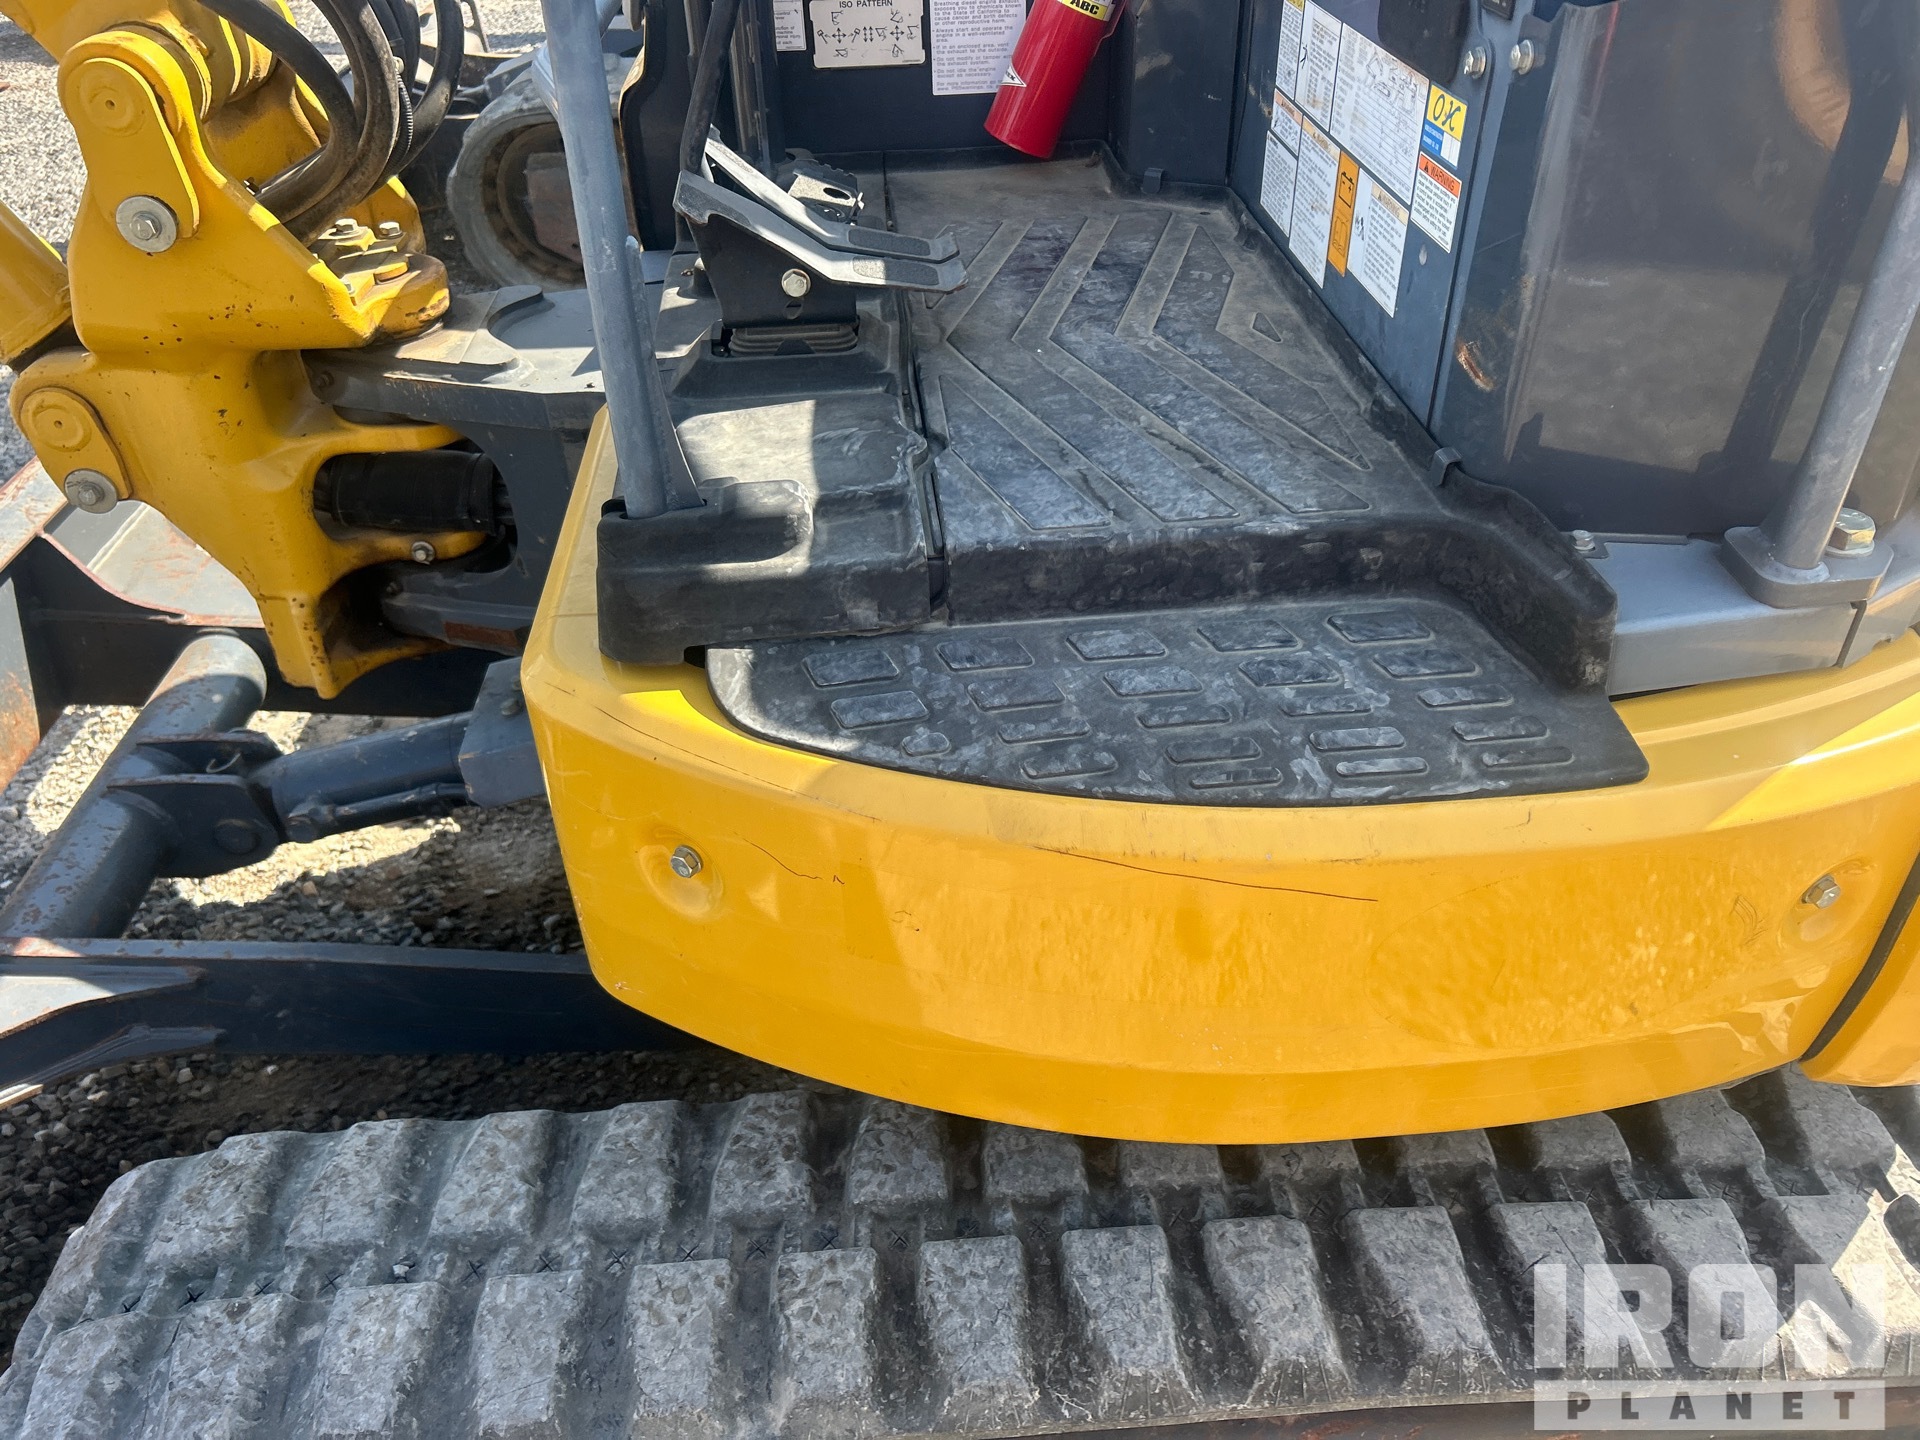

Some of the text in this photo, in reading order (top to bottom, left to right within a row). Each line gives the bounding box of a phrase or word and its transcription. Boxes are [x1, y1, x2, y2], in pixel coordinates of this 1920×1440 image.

[840, 0, 852, 8] ISO
[1070, 0, 1099, 14] ABC
[1430, 166, 1454, 192] WARNING
